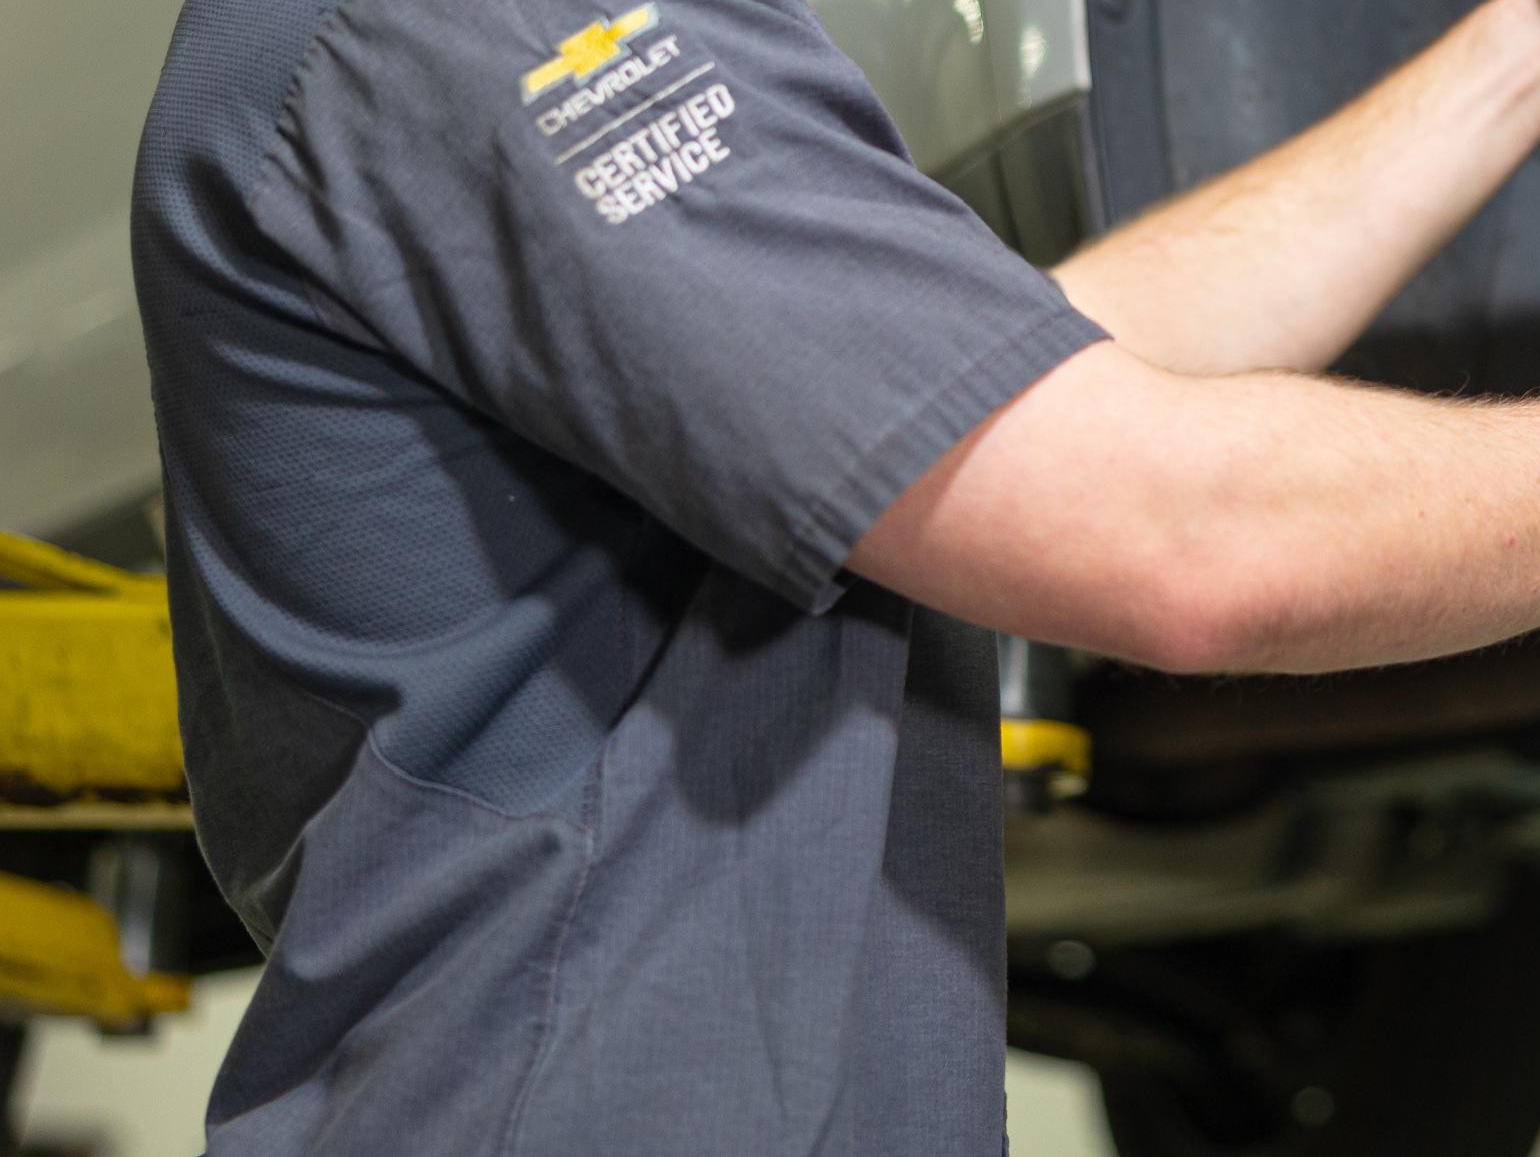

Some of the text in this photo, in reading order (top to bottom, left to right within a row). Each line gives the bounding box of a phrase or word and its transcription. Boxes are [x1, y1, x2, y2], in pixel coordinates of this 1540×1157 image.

[535, 34, 681, 136] CHEVROLET
[574, 83, 736, 199] CERTIFIED
[596, 127, 731, 225] SERVICE
